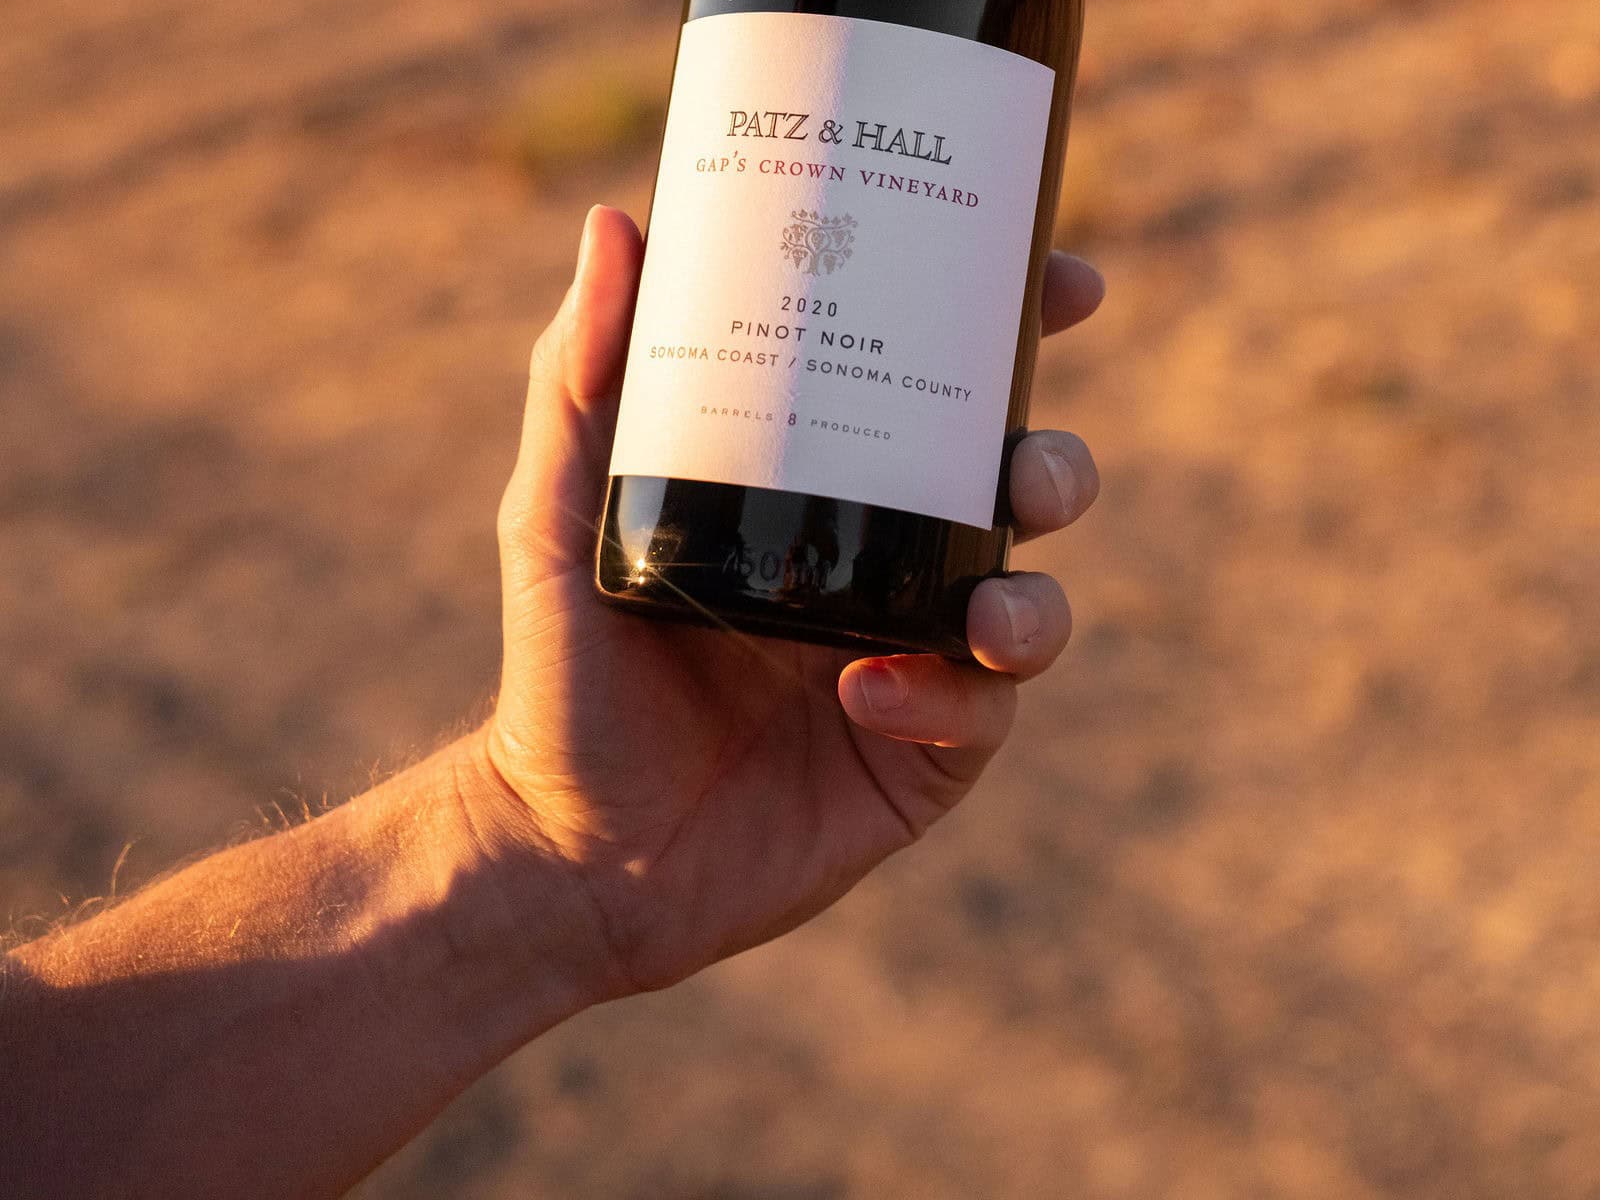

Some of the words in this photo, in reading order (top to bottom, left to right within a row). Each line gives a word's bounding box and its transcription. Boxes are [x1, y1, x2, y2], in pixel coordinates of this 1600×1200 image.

[726, 111, 810, 140] PATZ
[818, 119, 843, 144] &
[852, 120, 952, 165] HALL
[696, 150, 746, 173] GAP'S
[759, 159, 846, 182] CROWN
[859, 169, 979, 208] VINEYARD
[781, 296, 838, 317] 2020
[731, 320, 807, 341] PINOT
[820, 331, 884, 354] NOIR
[649, 346, 709, 361] SONOMA
[717, 349, 779, 367] COAST
[806, 359, 892, 385] SONOMA
[902, 376, 972, 401] COUNTY
[701, 406, 773, 421] BARRELS
[787, 412, 797, 426] 8
[810, 418, 891, 440] PRODUCED
